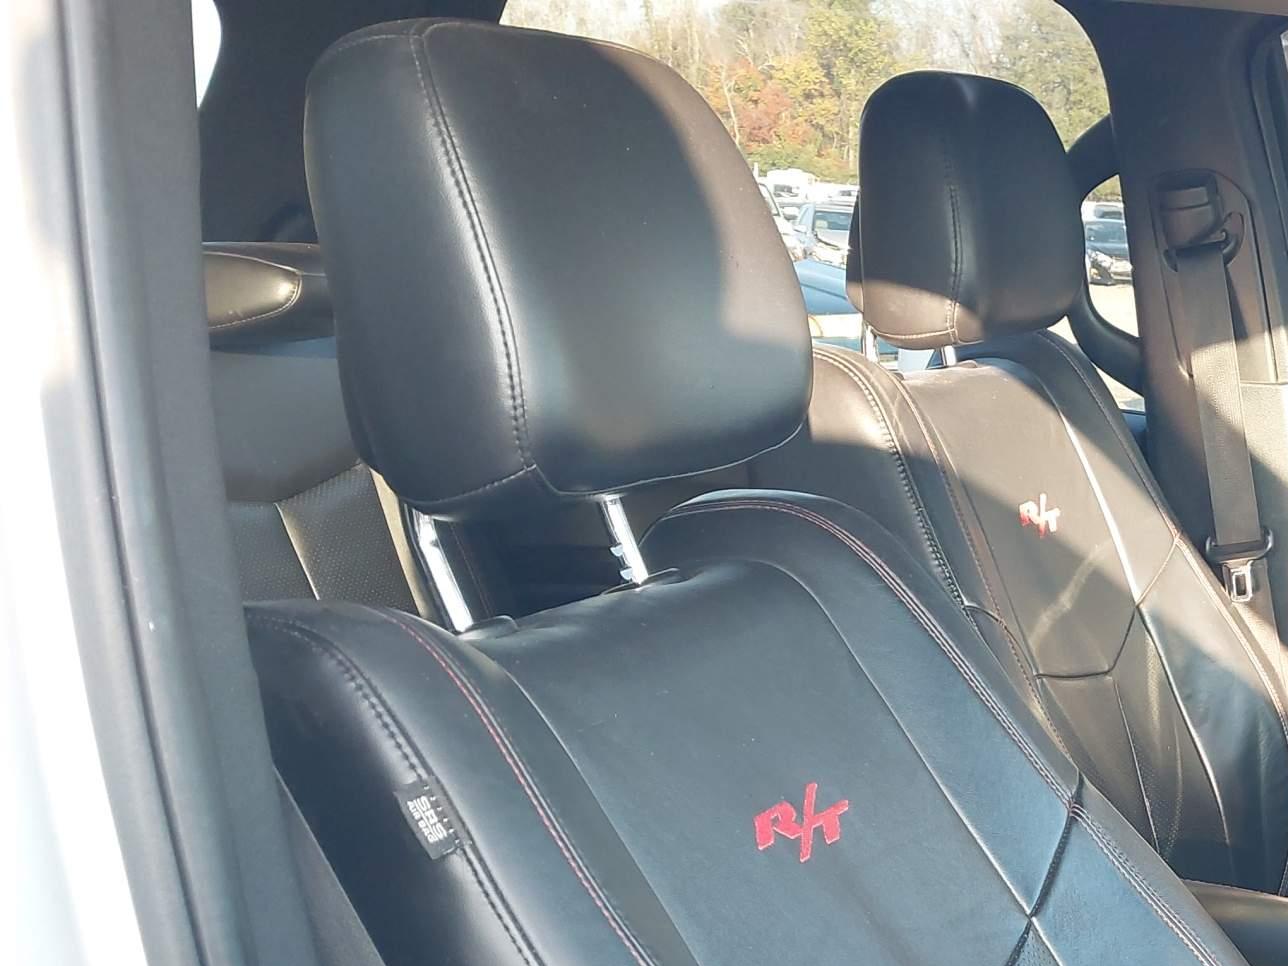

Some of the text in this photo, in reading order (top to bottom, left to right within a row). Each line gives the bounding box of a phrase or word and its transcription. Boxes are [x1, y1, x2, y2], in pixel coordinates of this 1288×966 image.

[1018, 492, 1061, 538] R/T
[416, 795, 448, 840] SRS
[754, 782, 849, 862] R/T
